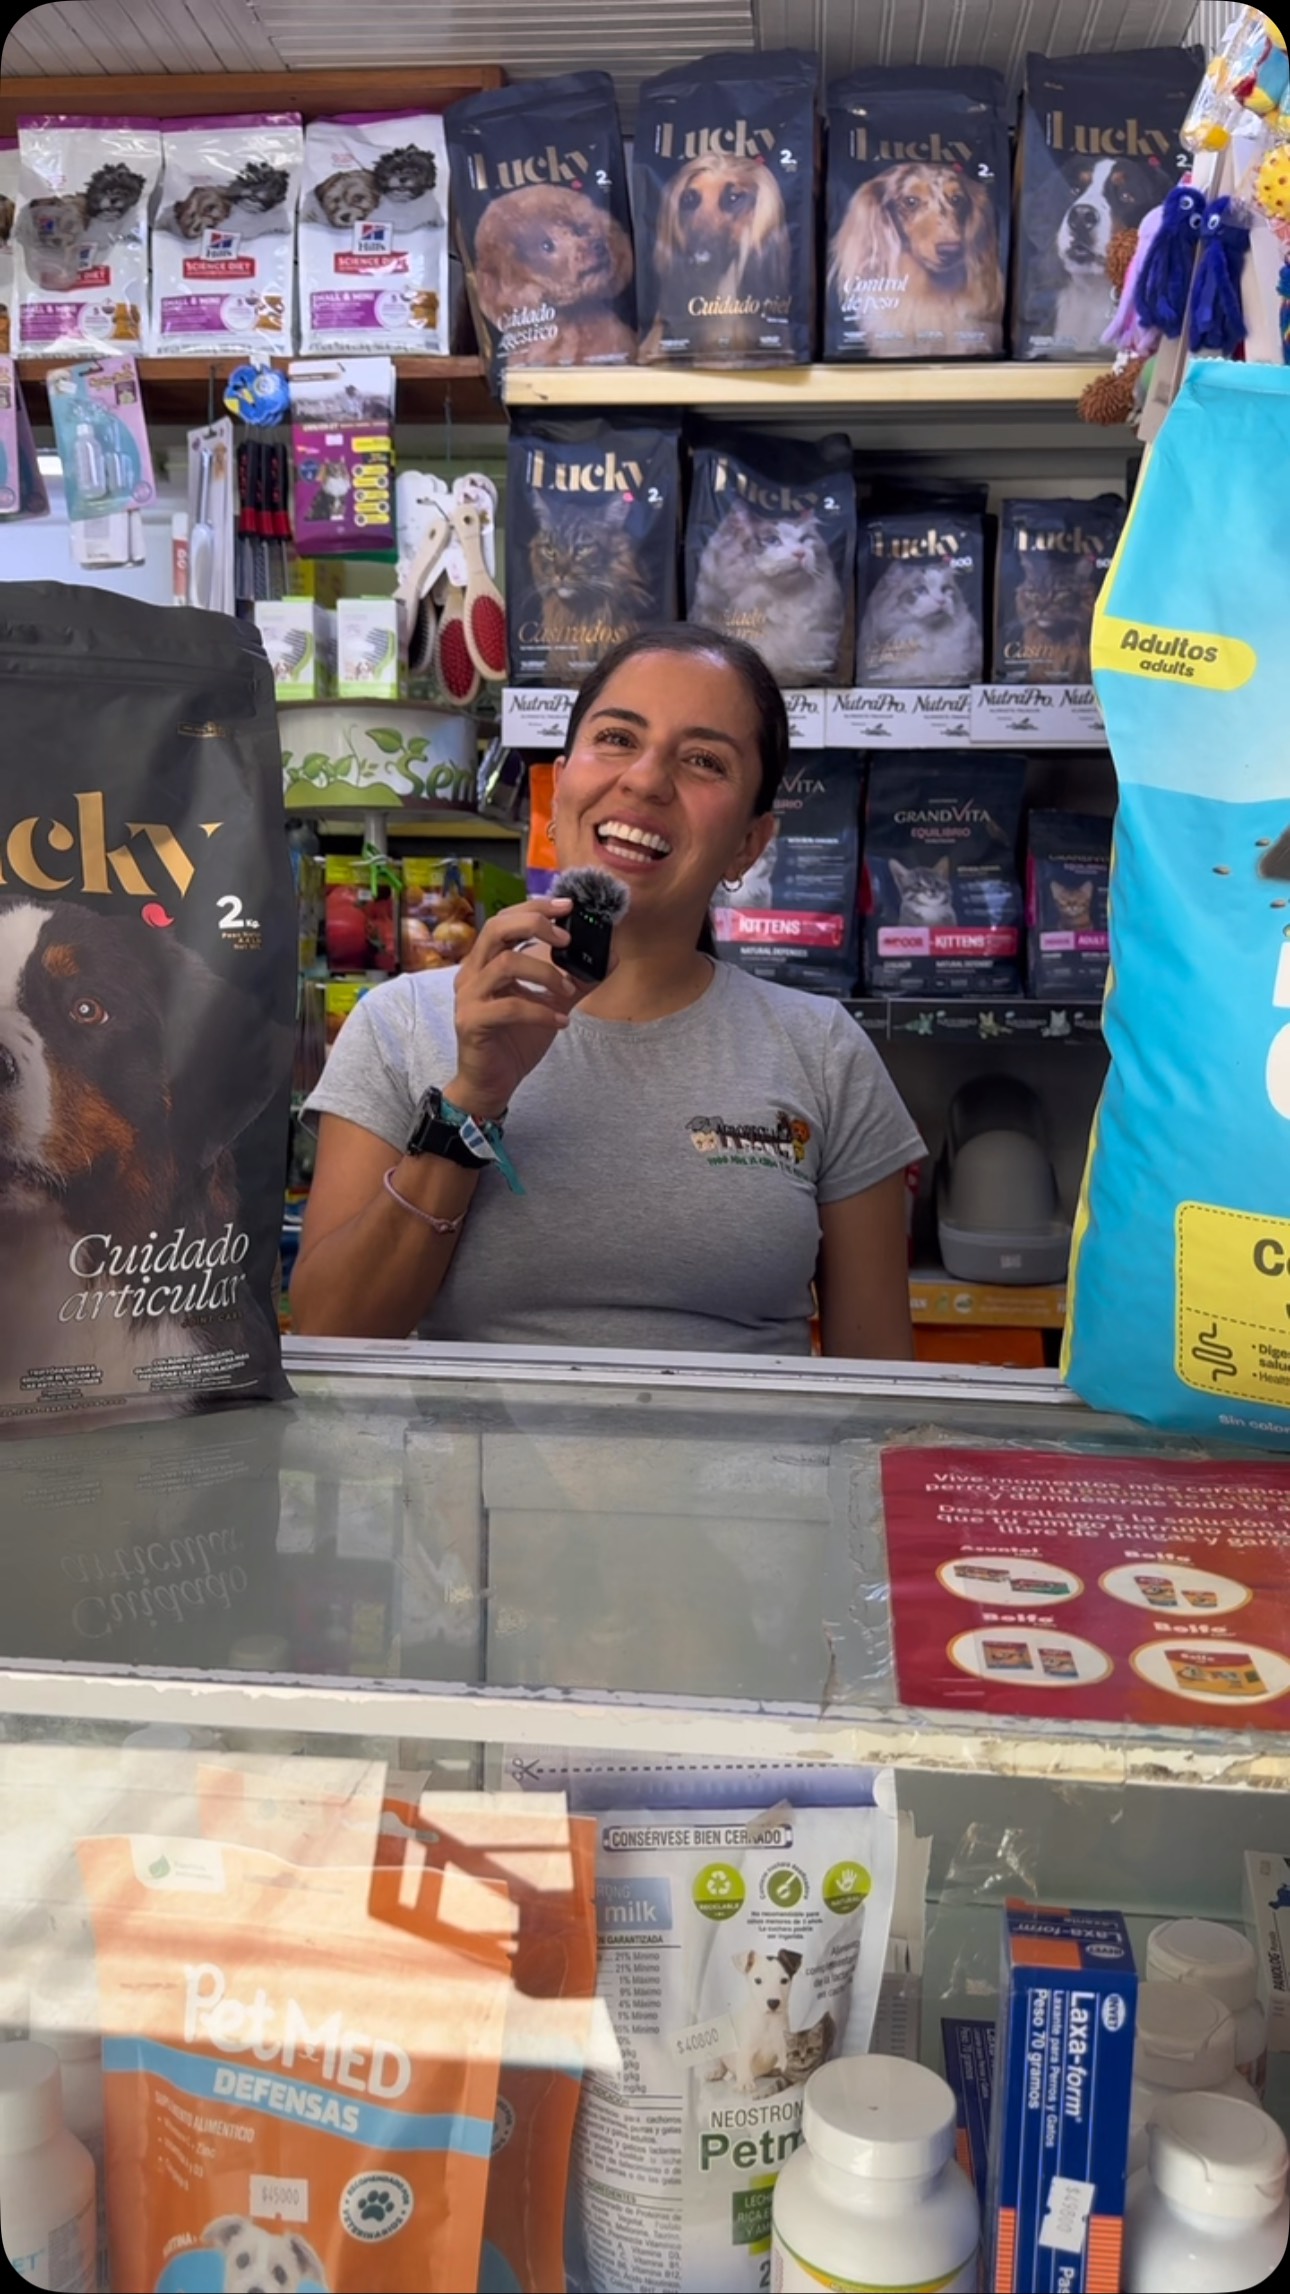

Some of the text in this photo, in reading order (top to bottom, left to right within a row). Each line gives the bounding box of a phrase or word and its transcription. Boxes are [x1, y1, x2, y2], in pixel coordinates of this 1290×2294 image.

[660, 119, 785, 160] Lucky
[855, 126, 981, 163] Lucky
[1052, 110, 1178, 157] Lucky
[474, 144, 596, 191] Lucky
[185, 260, 252, 271] SCIENCE DIET
[844, 273, 909, 295] Control
[688, 295, 760, 316] Cuidado
[532, 450, 652, 492] Lucky
[872, 529, 967, 559] Lucky
[1120, 628, 1219, 663] Adultos
[1139, 658, 1196, 678] adults
[894, 799, 991, 824] GRANDVITA
[0, 790, 224, 898] cky
[911, 827, 971, 840] EQUILIBRIO
[739, 917, 800, 936] KITTENS
[935, 935, 984, 949] KITTENS
[69, 1223, 250, 1278] Cuidado
[58, 1269, 247, 1322] articular
[925, 1483, 990, 1493] perro
[999, 1485, 1041, 1494] con
[1049, 1486, 1072, 1496] la
[934, 1472, 984, 1483] Vive
[992, 1477, 1121, 1490] momentos
[938, 1503, 1276, 1529] Desarrollamos la solución
[1174, 1499, 1235, 1511] todo
[1240, 1502, 1269, 1512] tu
[936, 1514, 985, 1525] que
[992, 1517, 1019, 1526] tu
[1027, 1517, 1107, 1532] amigo
[1115, 1523, 1222, 1537] perruno
[998, 1525, 1058, 1537] libre
[1067, 1529, 1100, 1539] de
[1108, 1531, 1198, 1544] pulgas
[960, 1544, 1040, 1554] Asuntol
[1123, 1549, 1192, 1563] Bolfo
[982, 1612, 1055, 1624] Bolfo
[1153, 1621, 1228, 1634] Bolfo
[612, 1826, 782, 1848] CONSÉRVESE BIEN CERADO
[605, 1900, 658, 1922] milk
[699, 1902, 740, 1911] RECICLABLE
[606, 1934, 663, 1945] GARANTIZADA
[1018, 1923, 1123, 1944] Laxa-form
[1052, 1990, 1065, 2036] Laxante
[184, 1963, 412, 2099] PetMED
[1028, 1988, 1049, 2110] Peso 70 gramos
[1050, 2036, 1060, 2064] para
[1065, 1991, 1096, 2117] Laxa-form
[1048, 2065, 1060, 2102] Perros
[213, 2066, 361, 2135] DEFENSAS
[193, 2114, 256, 2144] ALIMENTICIO
[1045, 2114, 1058, 2148] Gatos
[700, 2130, 803, 2171] Petm
[737, 2209, 762, 2223] RICA
